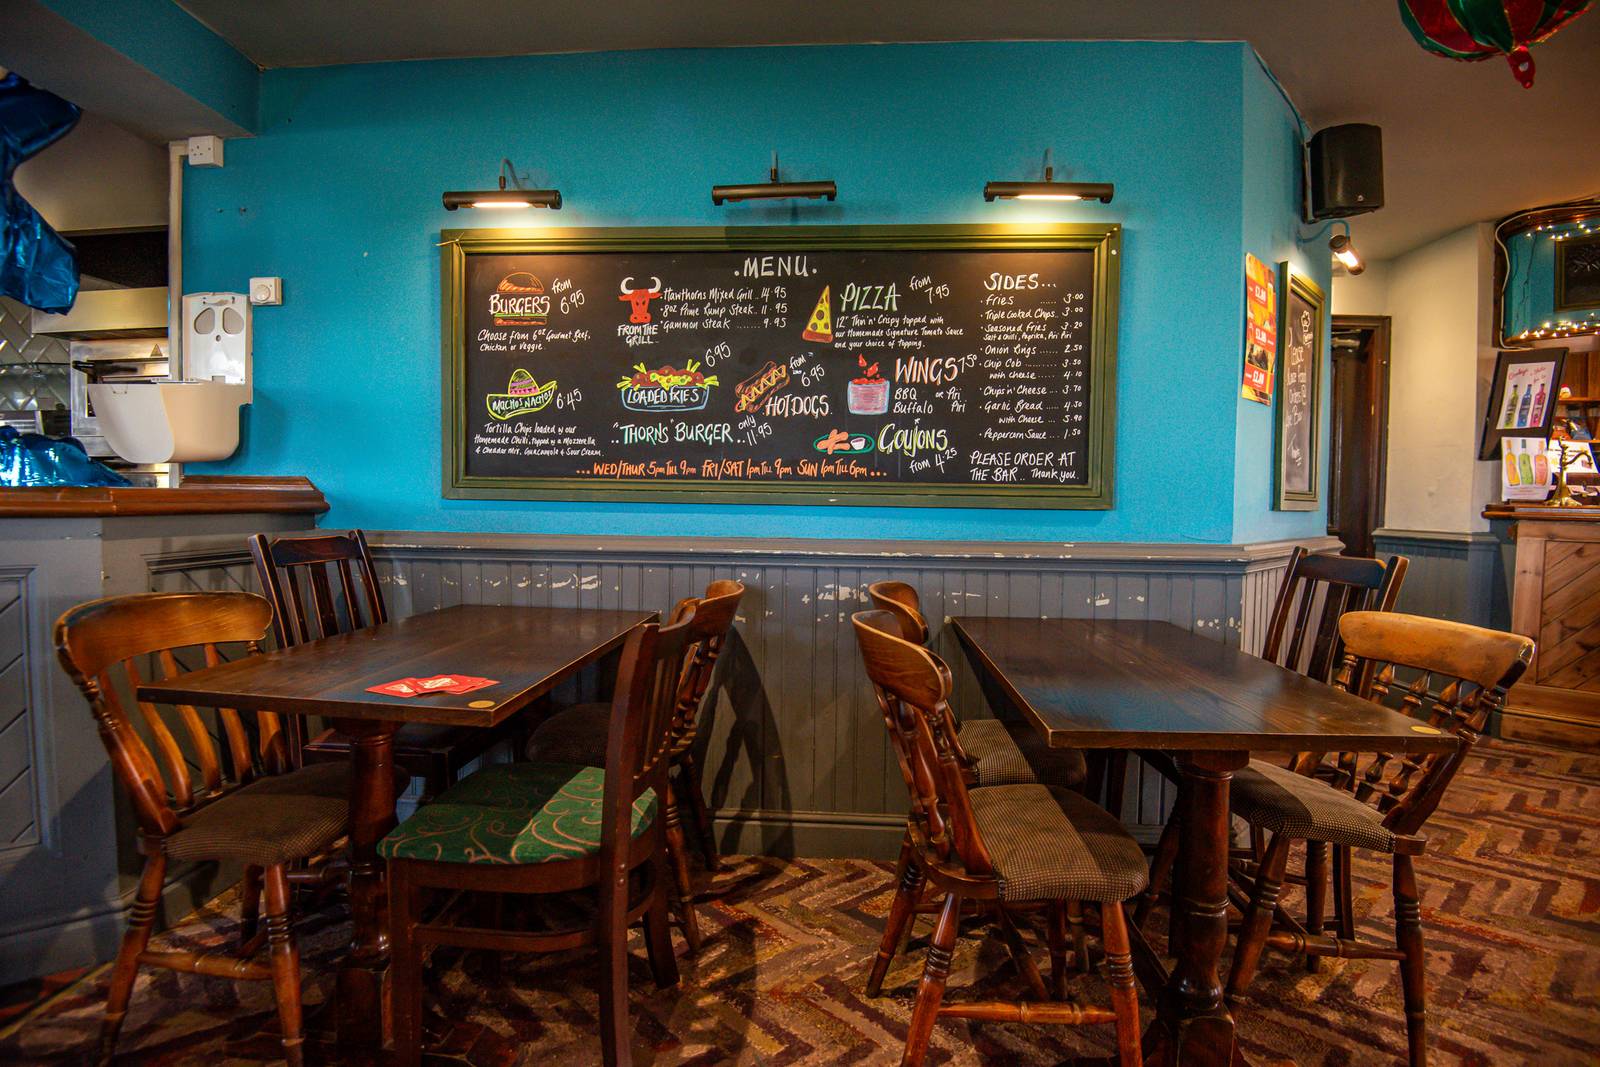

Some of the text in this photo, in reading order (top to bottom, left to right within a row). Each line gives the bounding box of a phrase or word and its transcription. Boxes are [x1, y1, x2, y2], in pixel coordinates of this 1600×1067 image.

[552, 278, 572, 294] from
[909, 275, 931, 291] from
[560, 289, 585, 314] 6.95
[663, 287, 706, 301] Hawthorns
[709, 288, 734, 302] Mixed
[840, 282, 902, 312] PIZZA
[924, 284, 950, 304] 7.95
[1063, 293, 1084, 304] 3.00
[488, 294, 550, 315] BURGERS
[680, 303, 700, 316] Prime
[703, 302, 726, 318] Rump
[761, 303, 788, 315] 11.95
[878, 314, 900, 328] Crispy
[903, 315, 926, 326] topped
[930, 313, 944, 324] with
[985, 309, 1005, 321] Triple
[1006, 309, 1032, 319] Cooked
[617, 322, 659, 336] FROM THE
[702, 318, 731, 329] Steak
[763, 317, 787, 329] 9.95
[984, 323, 1023, 332] Seasoned
[1060, 321, 1083, 330] 3.20
[477, 329, 507, 341] Choose
[509, 330, 529, 344] from
[546, 330, 571, 343] Gourmet
[847, 328, 884, 338] Homemade
[885, 328, 919, 339] Signature
[921, 327, 943, 336] Tomato
[944, 327, 964, 336] Sauce
[983, 333, 997, 341] Salt
[480, 343, 507, 353] Chicken
[510, 344, 516, 352] or
[849, 340, 863, 351] your
[865, 338, 885, 348] choice
[888, 339, 896, 349] of
[985, 344, 1009, 355] Onion
[1014, 343, 1037, 358] Rings
[705, 342, 731, 367] 6.95
[789, 354, 807, 370] from
[895, 356, 959, 385] WINGS
[983, 358, 1002, 368] Chip
[1005, 358, 1022, 368] Cob
[801, 364, 825, 387] 6.95
[989, 370, 1006, 379] with
[556, 388, 582, 411] 6.45
[627, 388, 668, 405] LOADED
[894, 387, 917, 400] BBQ
[893, 401, 933, 414] Buffalo
[984, 400, 1011, 413] Garlic
[1014, 399, 1043, 413] Bread
[738, 415, 756, 430] only
[998, 413, 1016, 424] with
[484, 421, 512, 433] Tortilla
[514, 421, 532, 435] Chips
[534, 421, 556, 433] loaded
[565, 425, 577, 434] our
[747, 422, 772, 446] 11.95
[984, 427, 1024, 441] Peppercorn
[1025, 428, 1047, 439] Sauce
[474, 434, 509, 445] Homemade
[566, 447, 580, 456] Sour
[969, 450, 1076, 467] PLEASE ORDER AT
[797, 459, 818, 477] SUN
[910, 459, 930, 474] from
[970, 467, 990, 481] THE
[1031, 468, 1058, 480] Thank
